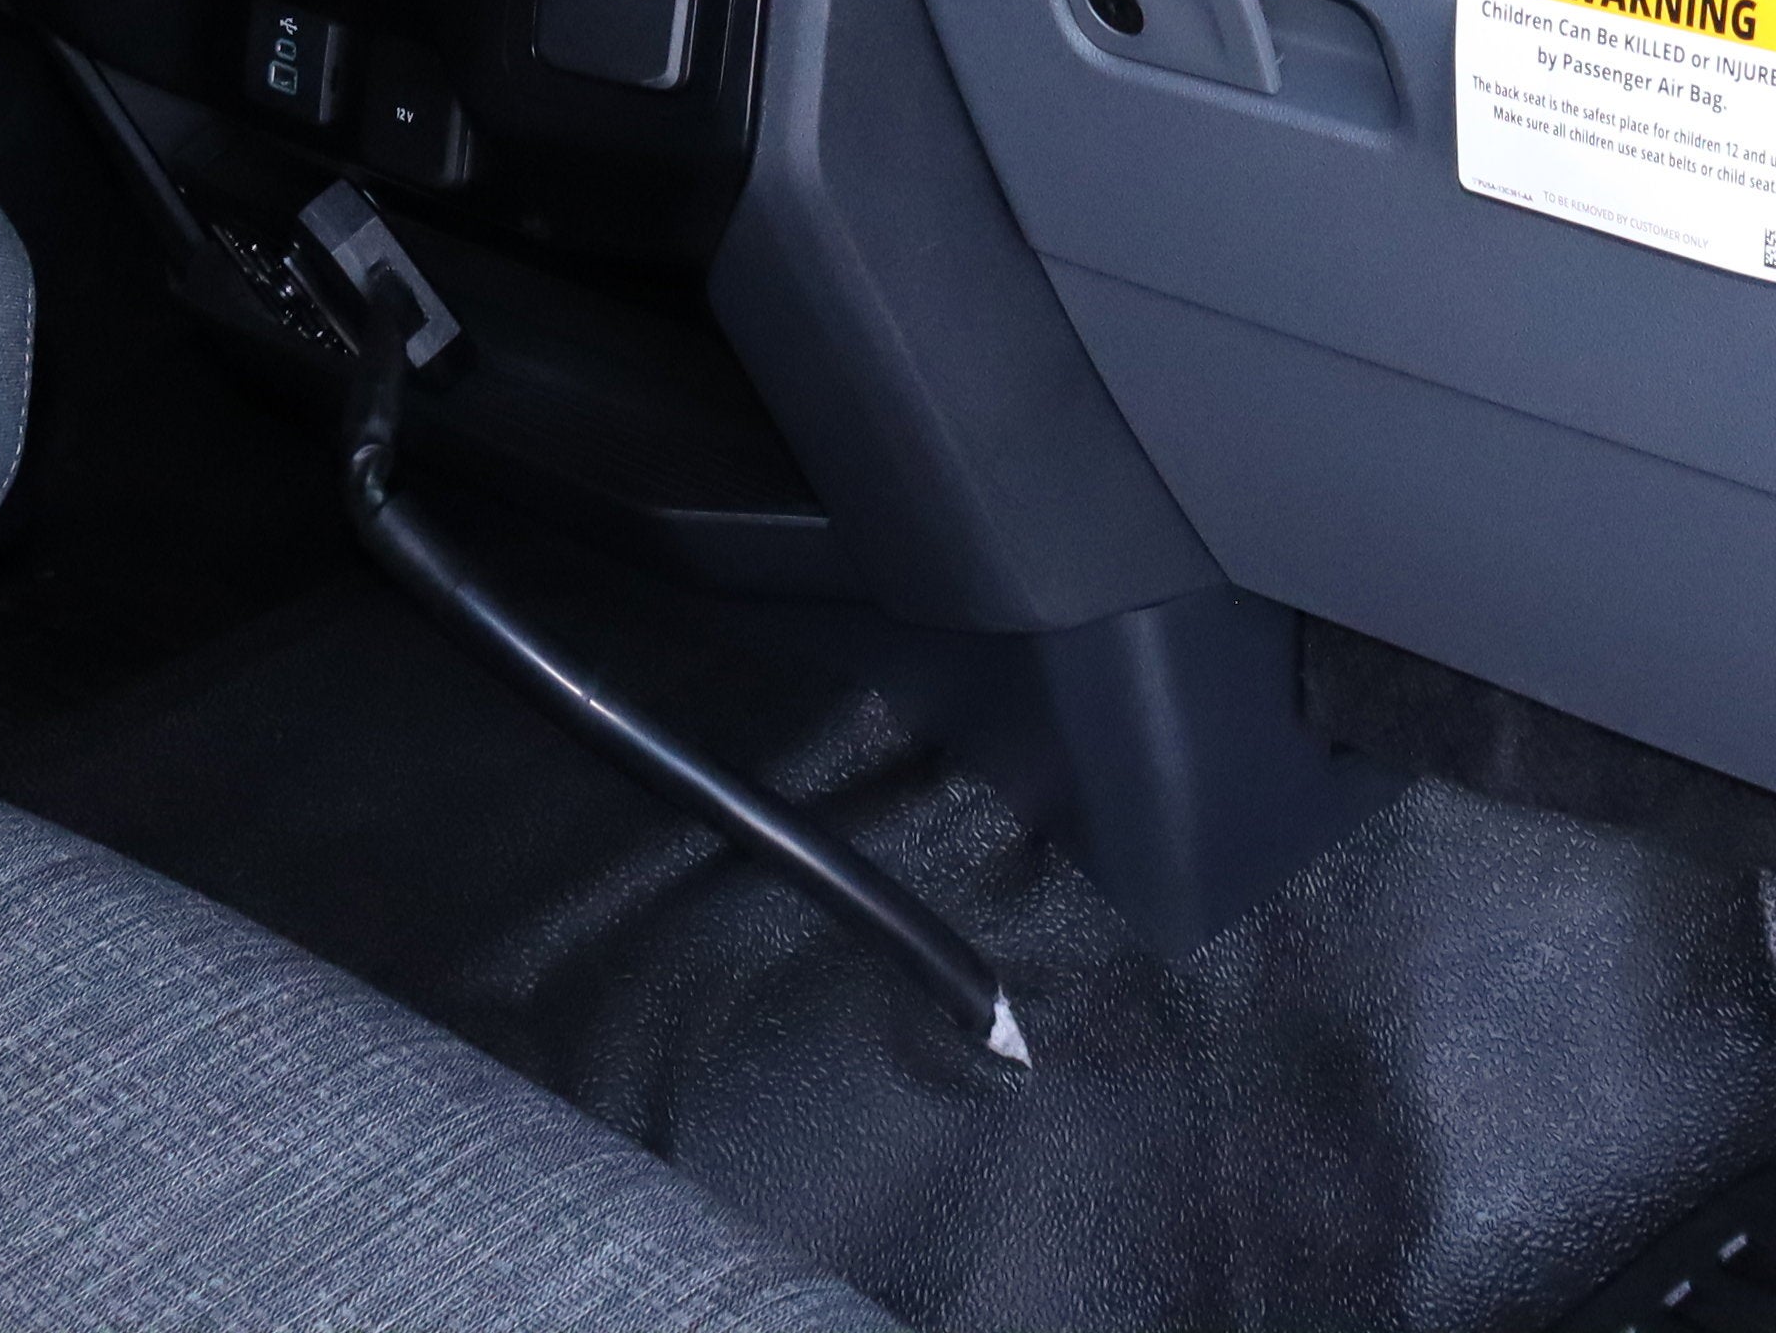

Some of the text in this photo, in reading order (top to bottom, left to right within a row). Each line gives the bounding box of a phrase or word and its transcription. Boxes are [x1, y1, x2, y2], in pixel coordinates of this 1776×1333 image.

[1557, 17, 1592, 43] Can
[1597, 27, 1619, 49] Be
[1623, 33, 1686, 65] KILLED
[1690, 53, 1711, 71] or
[1537, 45, 1728, 114] by Passenger Air Bag.
[1472, 74, 1493, 93] The
[1494, 80, 1520, 102] back
[1522, 89, 1547, 108] seat
[1549, 94, 1558, 112] is
[1560, 98, 1580, 118] the
[1582, 102, 1616, 128] safest
[1619, 111, 1650, 137] place
[1652, 121, 1671, 142] for
[1673, 126, 1721, 155] children
[1725, 141, 1739, 160] 12
[1743, 145, 1767, 166] and
[1493, 104, 1523, 127] Make
[1526, 115, 1550, 136] sure
[1552, 120, 1567, 139] all
[1569, 125, 1615, 152] children
[1618, 139, 1638, 159] use
[1640, 145, 1666, 166] seat
[1668, 151, 1697, 174] belts
[1700, 162, 1714, 179] or
[1716, 166, 1746, 188] child
[1542, 190, 1556, 205] TO
[1558, 195, 1570, 209] BE
[1570, 199, 1615, 222] REMOVED
[1616, 213, 1628, 227] BY
[1629, 217, 1681, 243] CUSTOMER
[1682, 232, 1709, 250] ONLY
